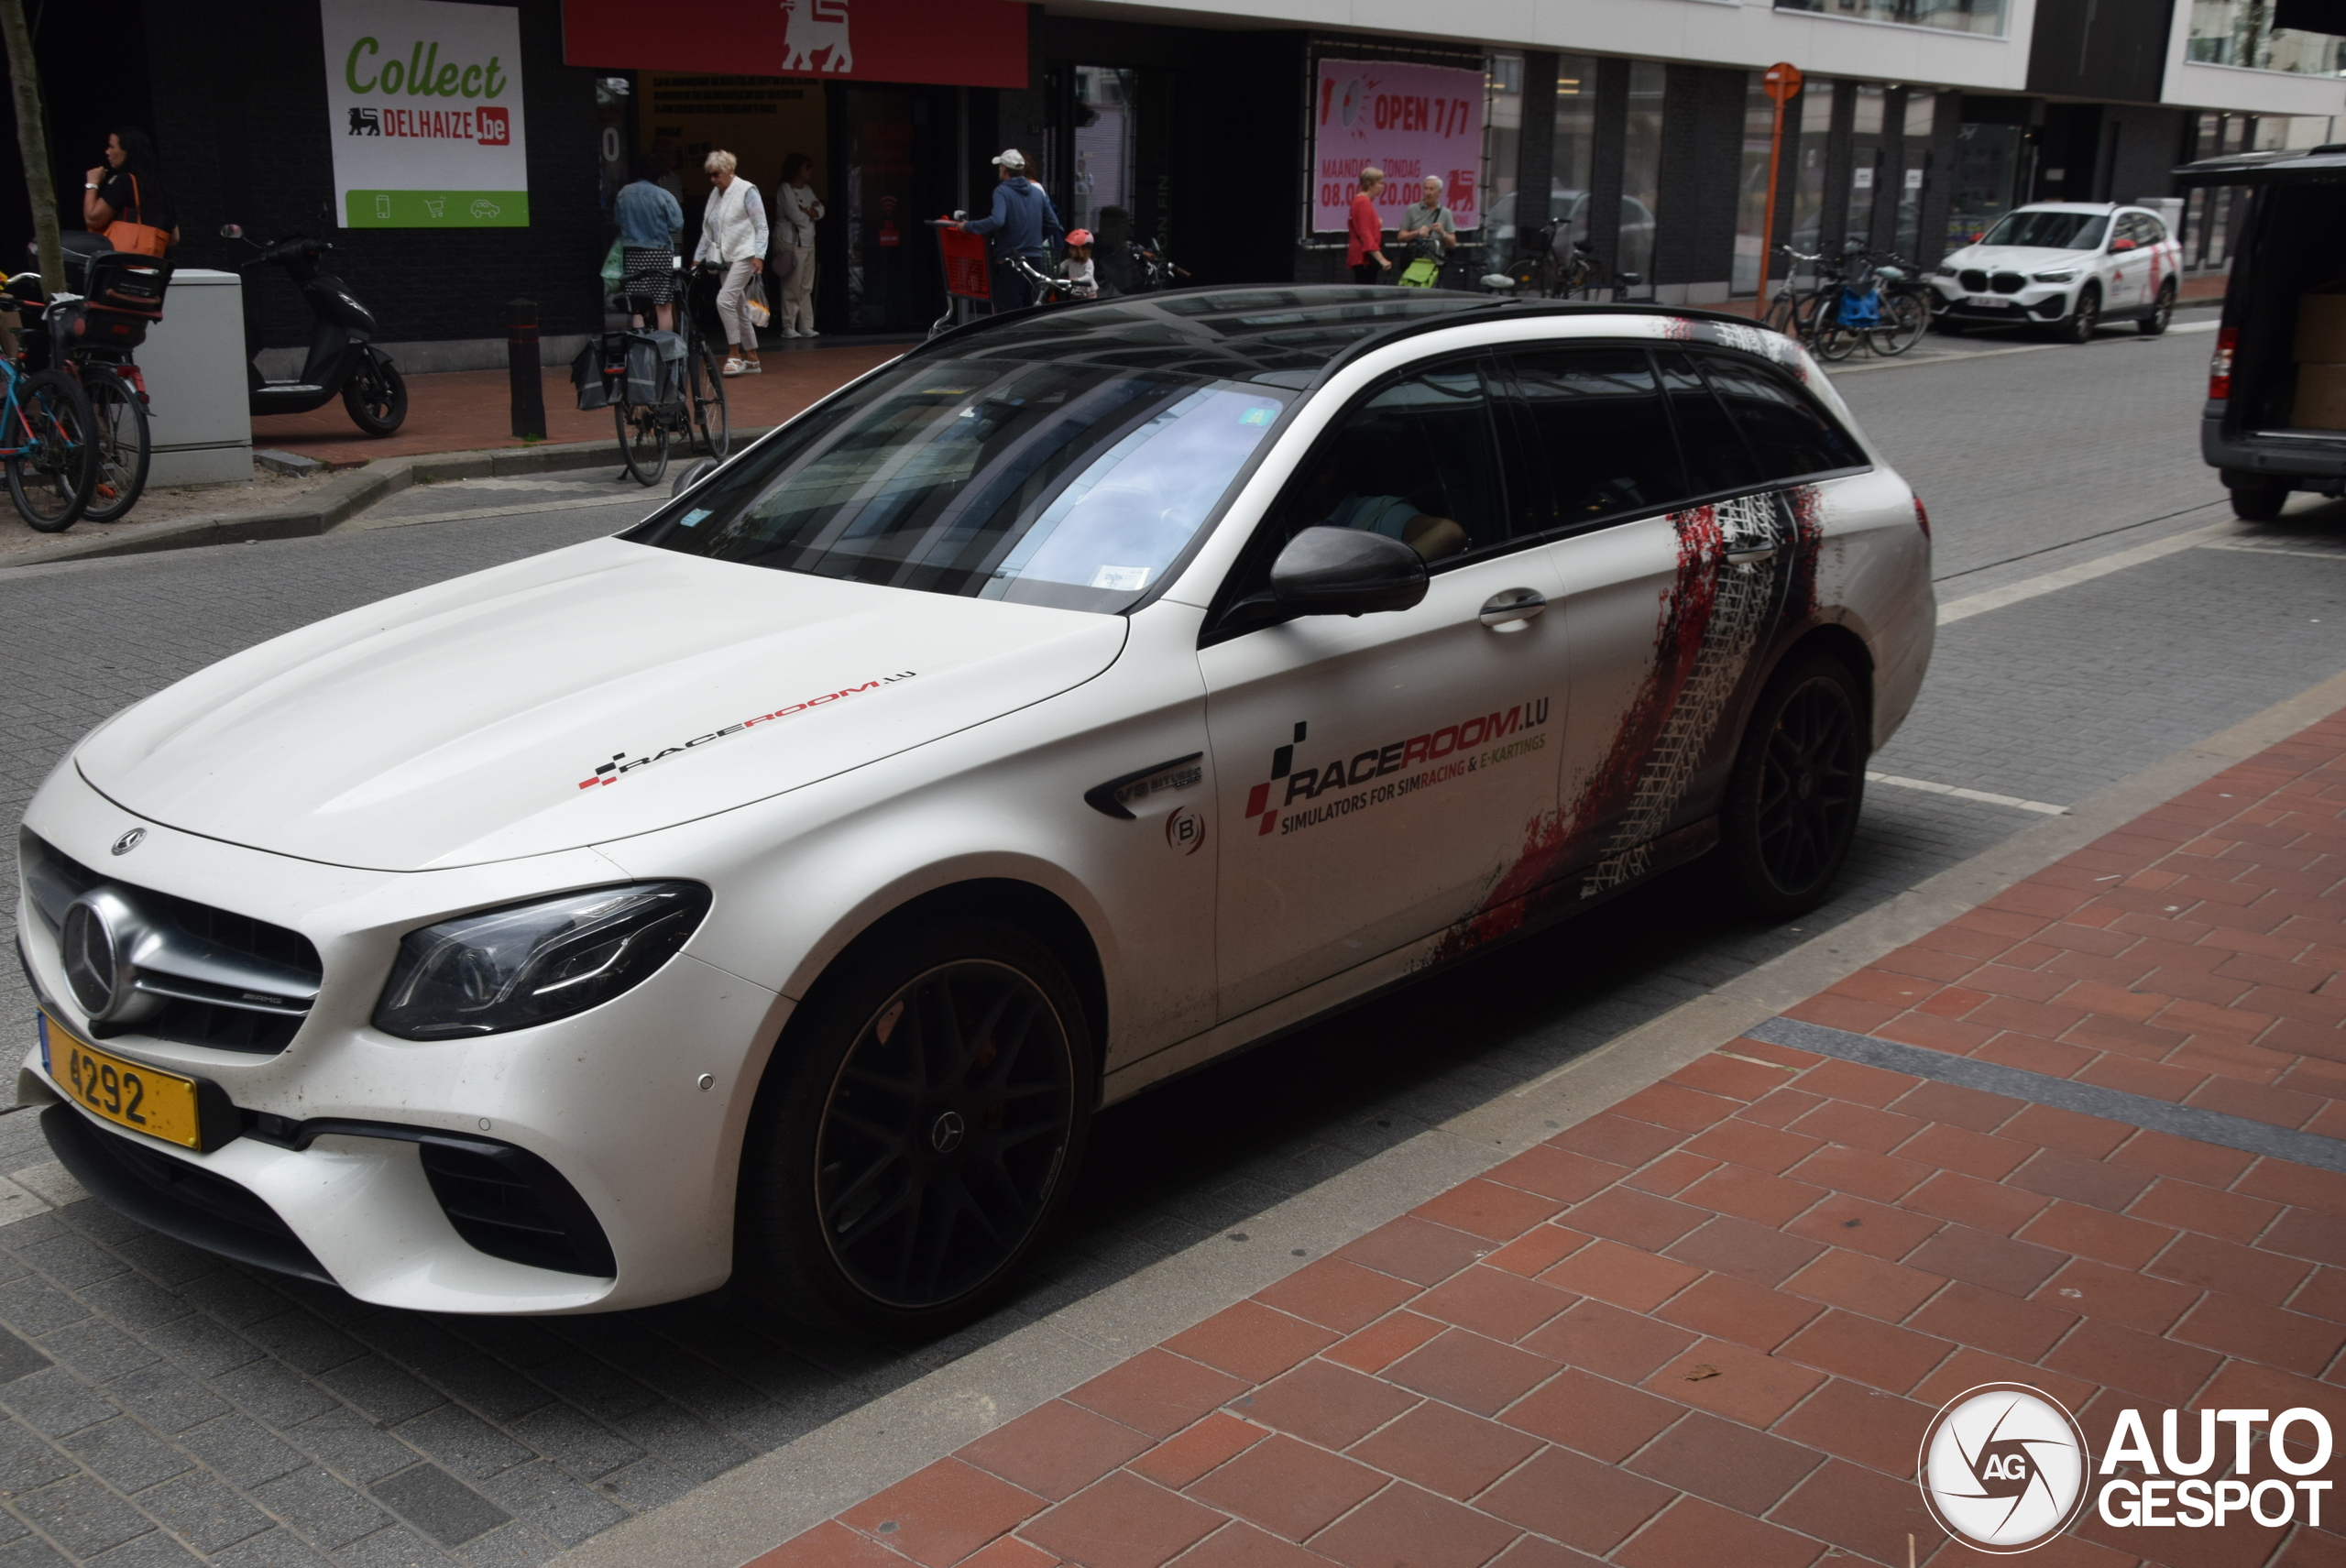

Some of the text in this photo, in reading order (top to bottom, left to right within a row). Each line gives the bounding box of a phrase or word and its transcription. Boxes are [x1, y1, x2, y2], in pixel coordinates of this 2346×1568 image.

[345, 37, 507, 99] Collect
[1375, 93, 1470, 138] OPEN 7/7
[1157, 175, 1168, 208] FIN
[1383, 159, 1420, 179] ZONDAG
[1379, 181, 1421, 206] 20.00
[618, 671, 916, 775] RACEROOM.LU
[1284, 696, 1550, 807] RACEROOM.LU
[1281, 733, 1547, 836] SIMULATORS FOR SIMRACING & E-KARTINGS
[1178, 818, 1194, 840] B
[255, 994, 282, 1004] AMG
[70, 1047, 146, 1126] 4292
